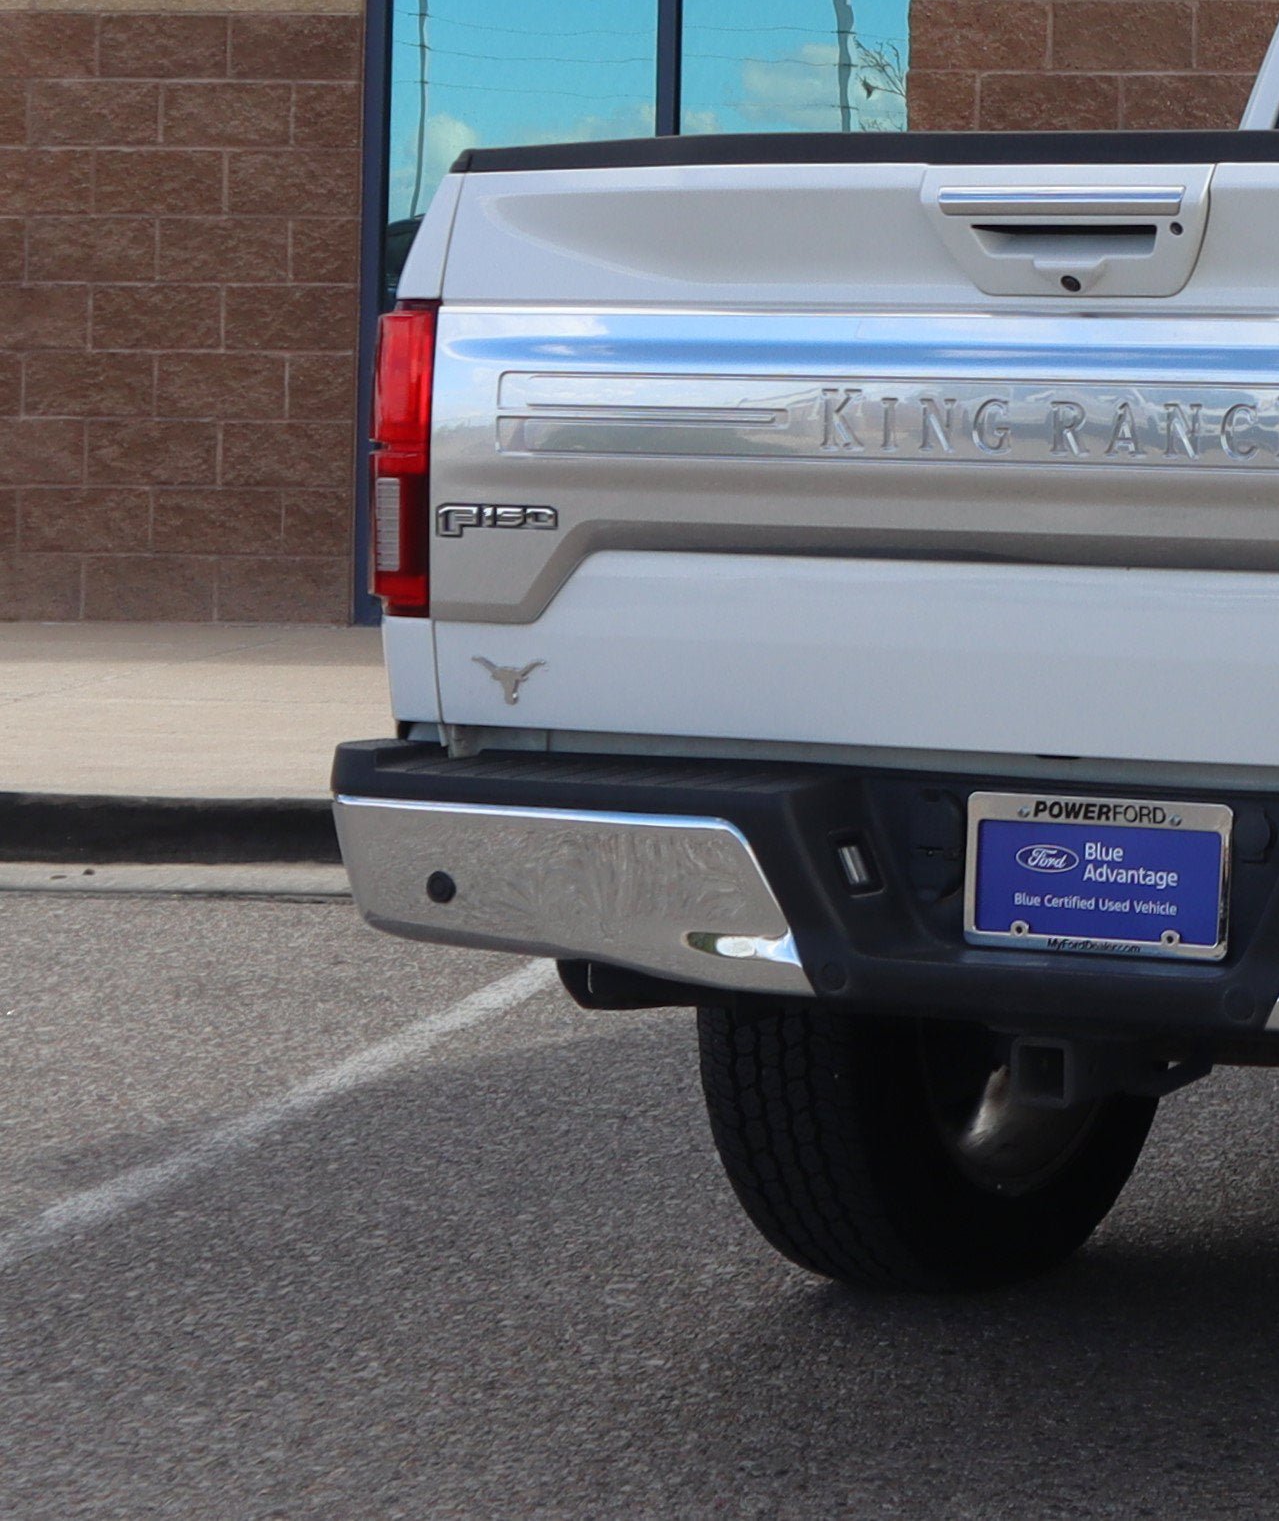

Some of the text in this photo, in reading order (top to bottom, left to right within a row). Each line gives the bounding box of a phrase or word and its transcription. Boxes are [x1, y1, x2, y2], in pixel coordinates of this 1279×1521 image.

[819, 387, 1012, 454] KING
[1033, 800, 1167, 825] POWERFORD
[1027, 847, 1069, 869] Ford
[1084, 841, 1124, 862] Blue
[1082, 863, 1179, 890] Advantage
[1013, 891, 1178, 917] Blue Certified Used Vehicle
